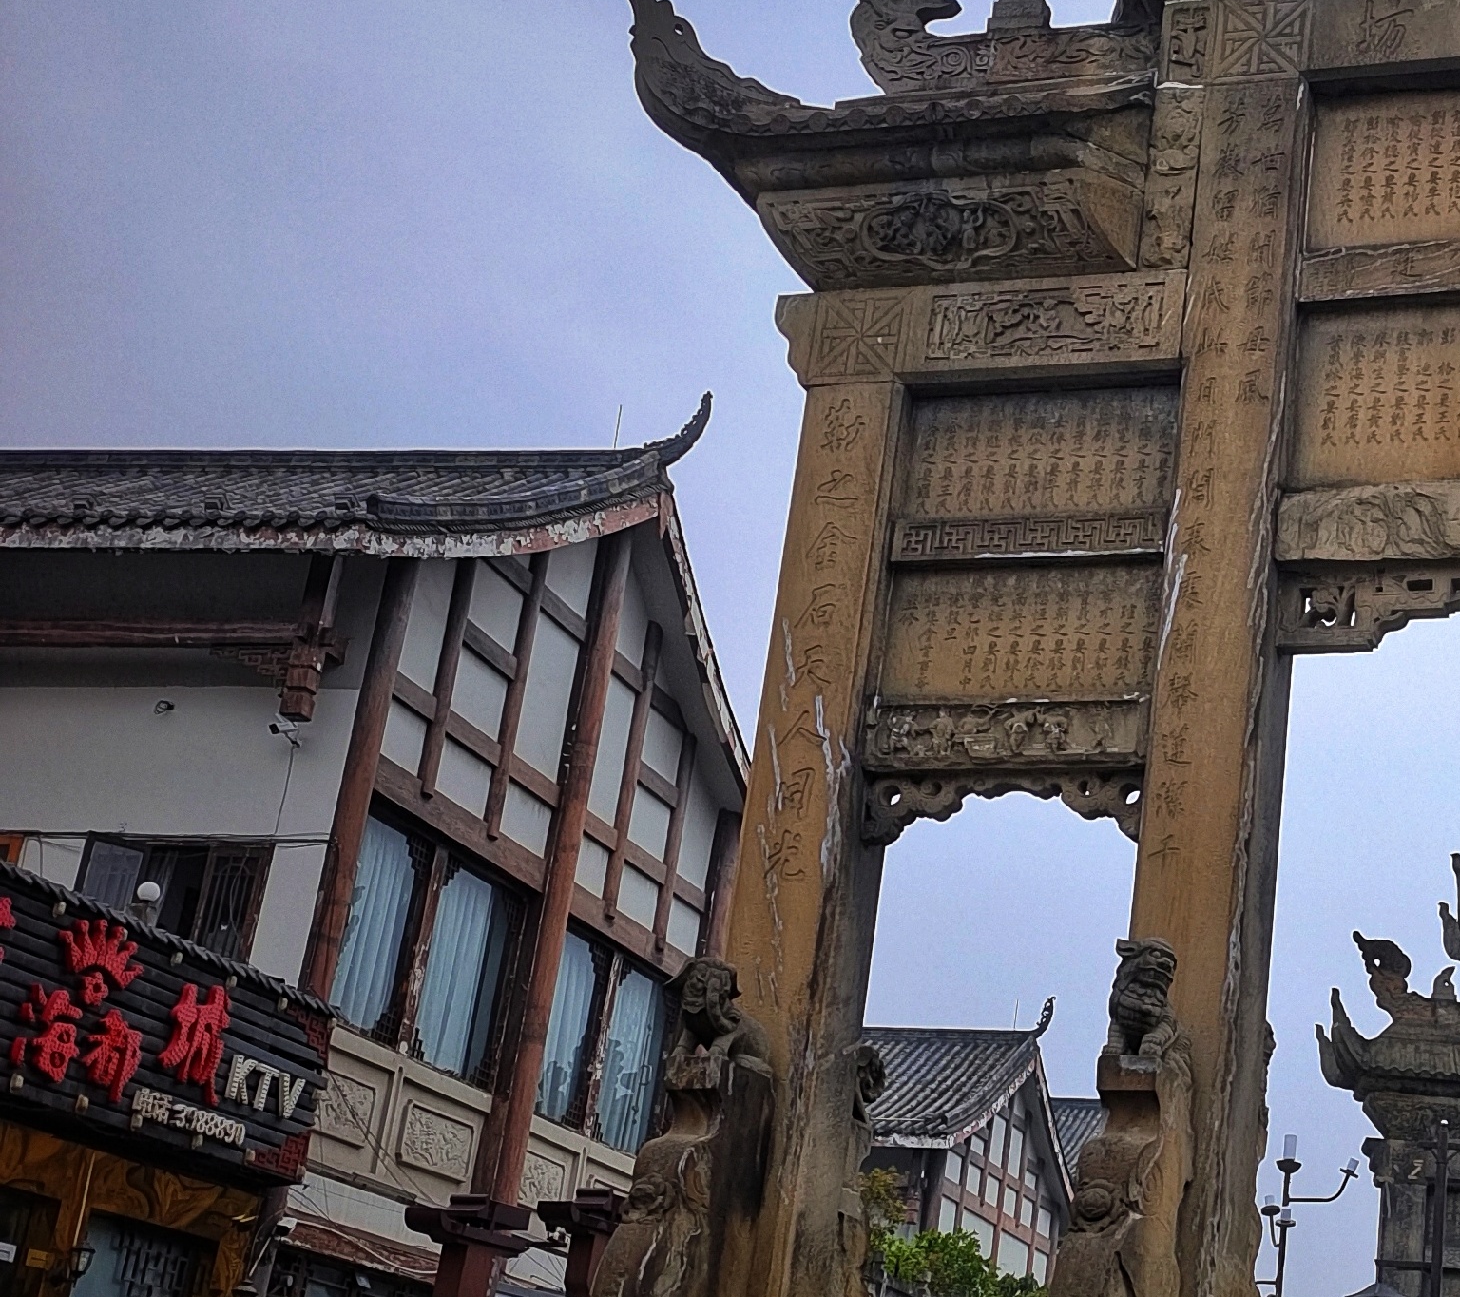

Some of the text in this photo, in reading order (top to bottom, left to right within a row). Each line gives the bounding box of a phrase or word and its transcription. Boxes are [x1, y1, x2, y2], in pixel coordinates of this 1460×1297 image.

[763, 396, 865, 881] 勒之金石天人同光
[224, 1054, 306, 1119] KTV
